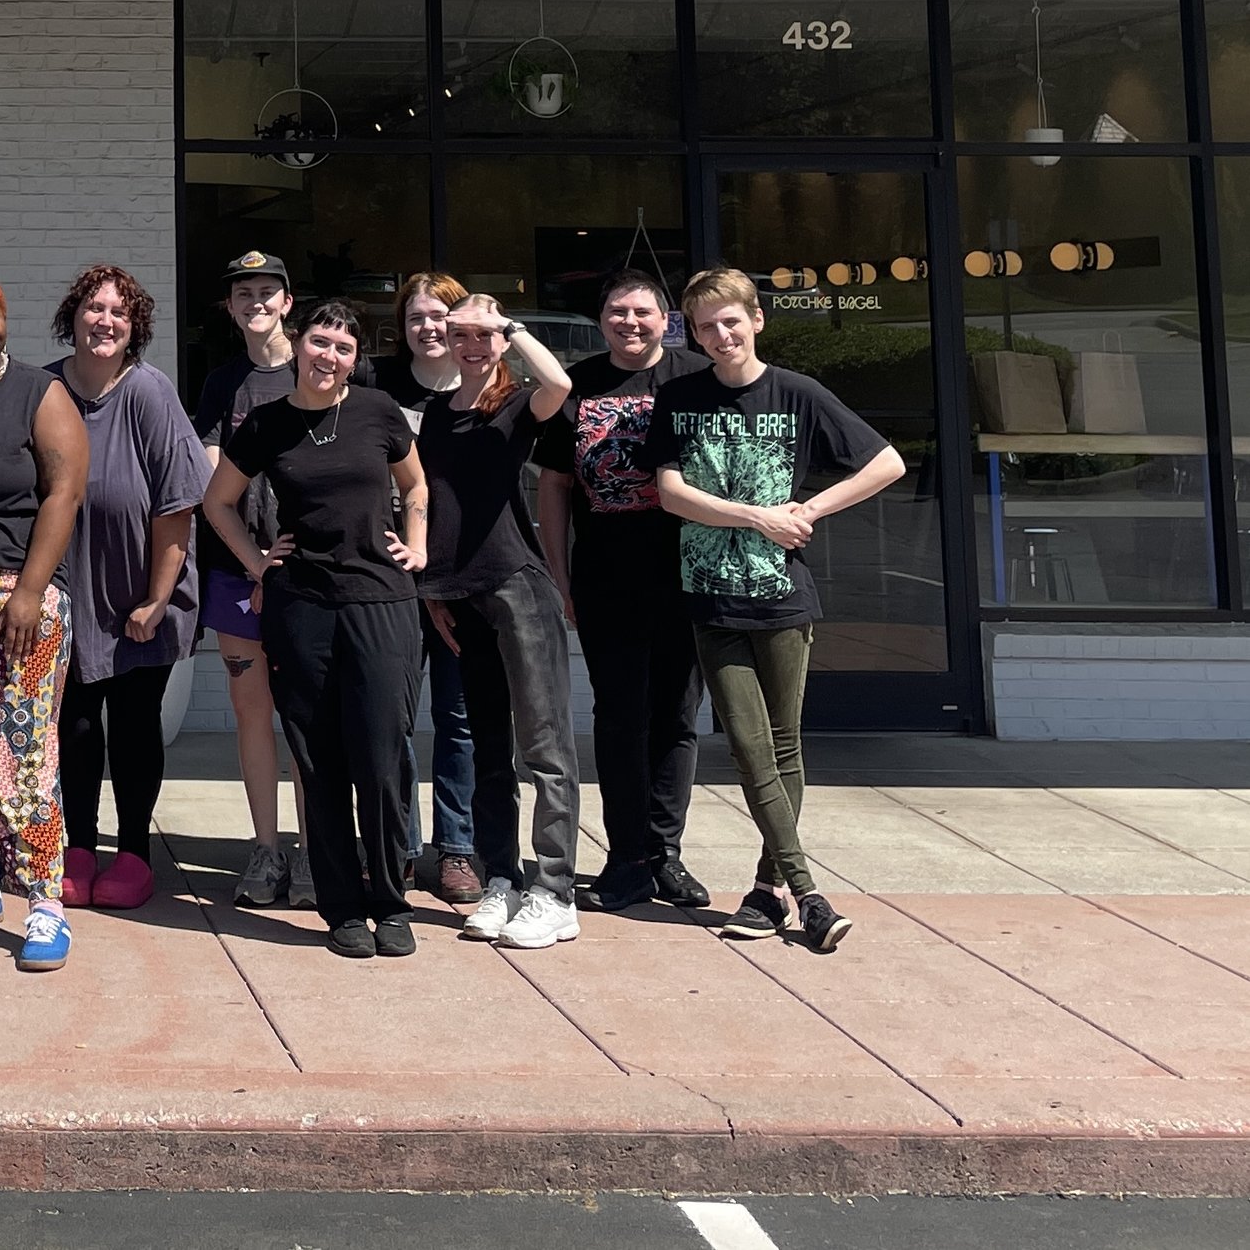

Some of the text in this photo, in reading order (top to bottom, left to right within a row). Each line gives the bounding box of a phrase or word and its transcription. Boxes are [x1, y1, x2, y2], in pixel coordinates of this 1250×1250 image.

[782, 20, 853, 50] 432
[772, 295, 882, 310] POTCHKE BAGEL
